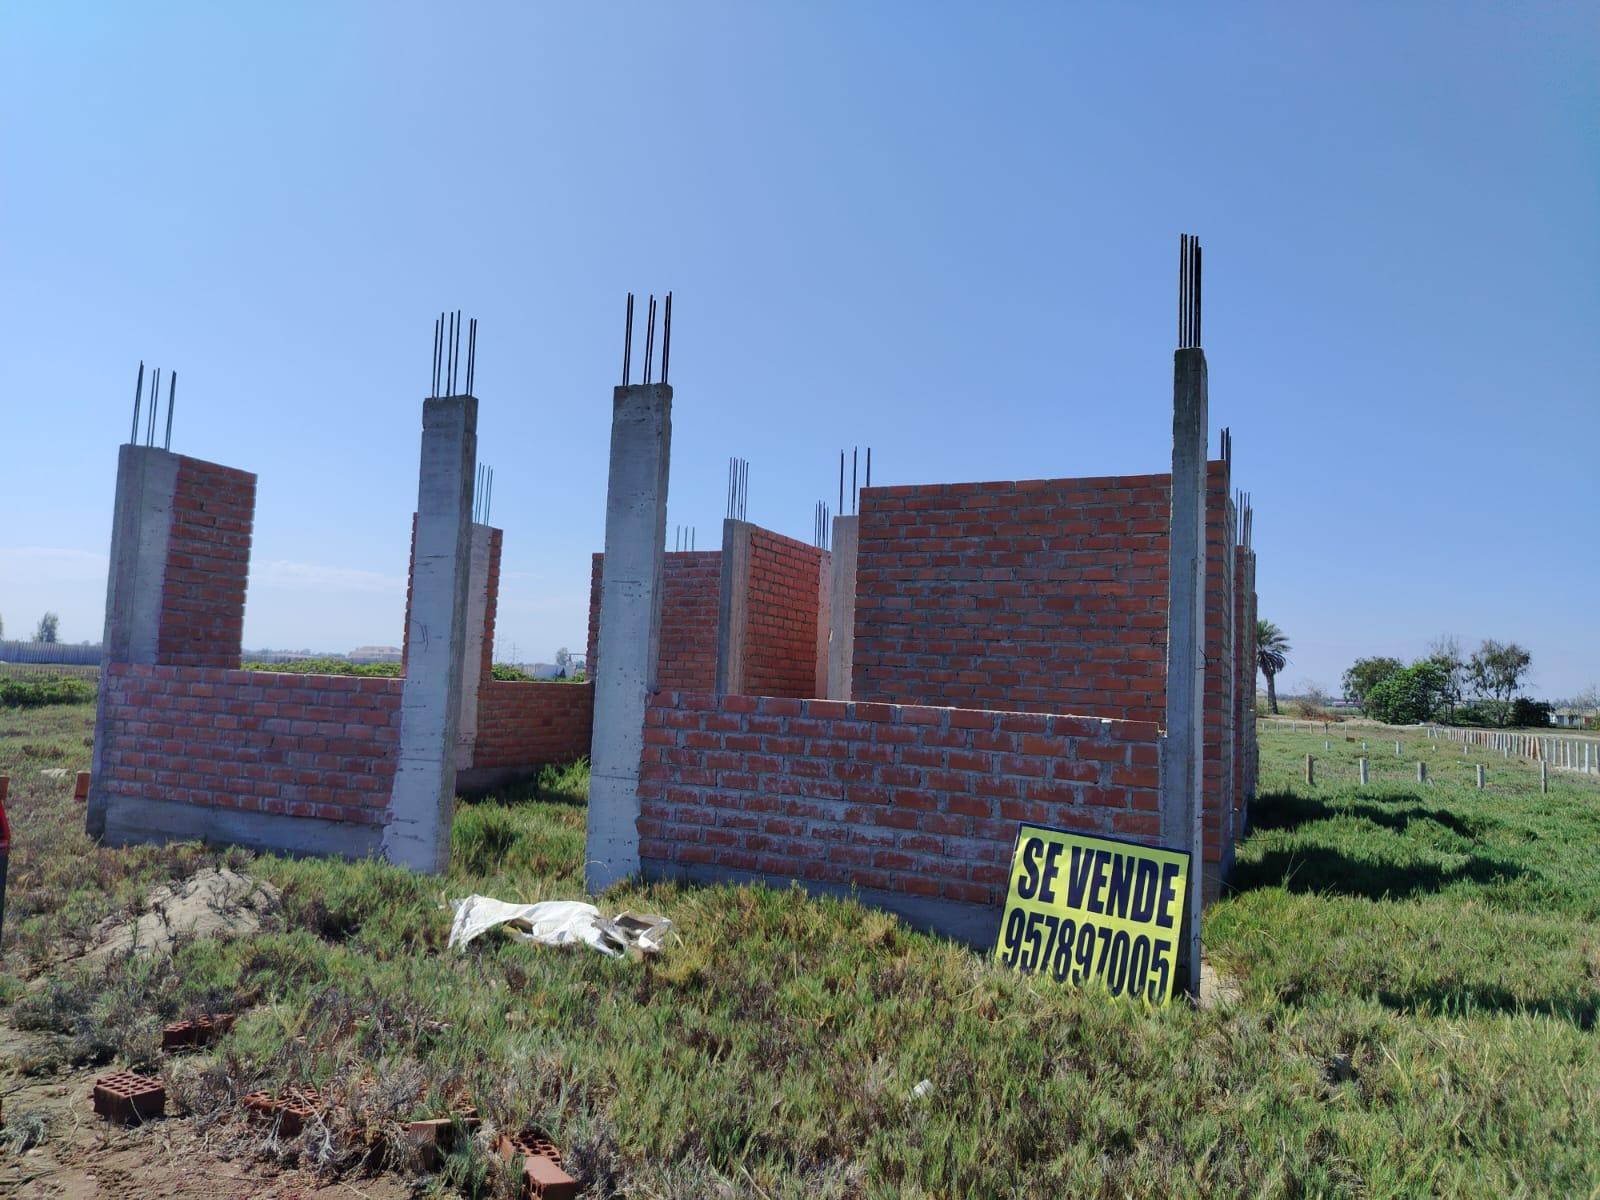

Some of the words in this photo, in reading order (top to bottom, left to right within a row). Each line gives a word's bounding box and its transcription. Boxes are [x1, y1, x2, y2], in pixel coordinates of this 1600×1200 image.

[1018, 837, 1064, 904] SE
[1067, 846, 1180, 929] VENDE
[1002, 907, 1172, 1006] 957897005
